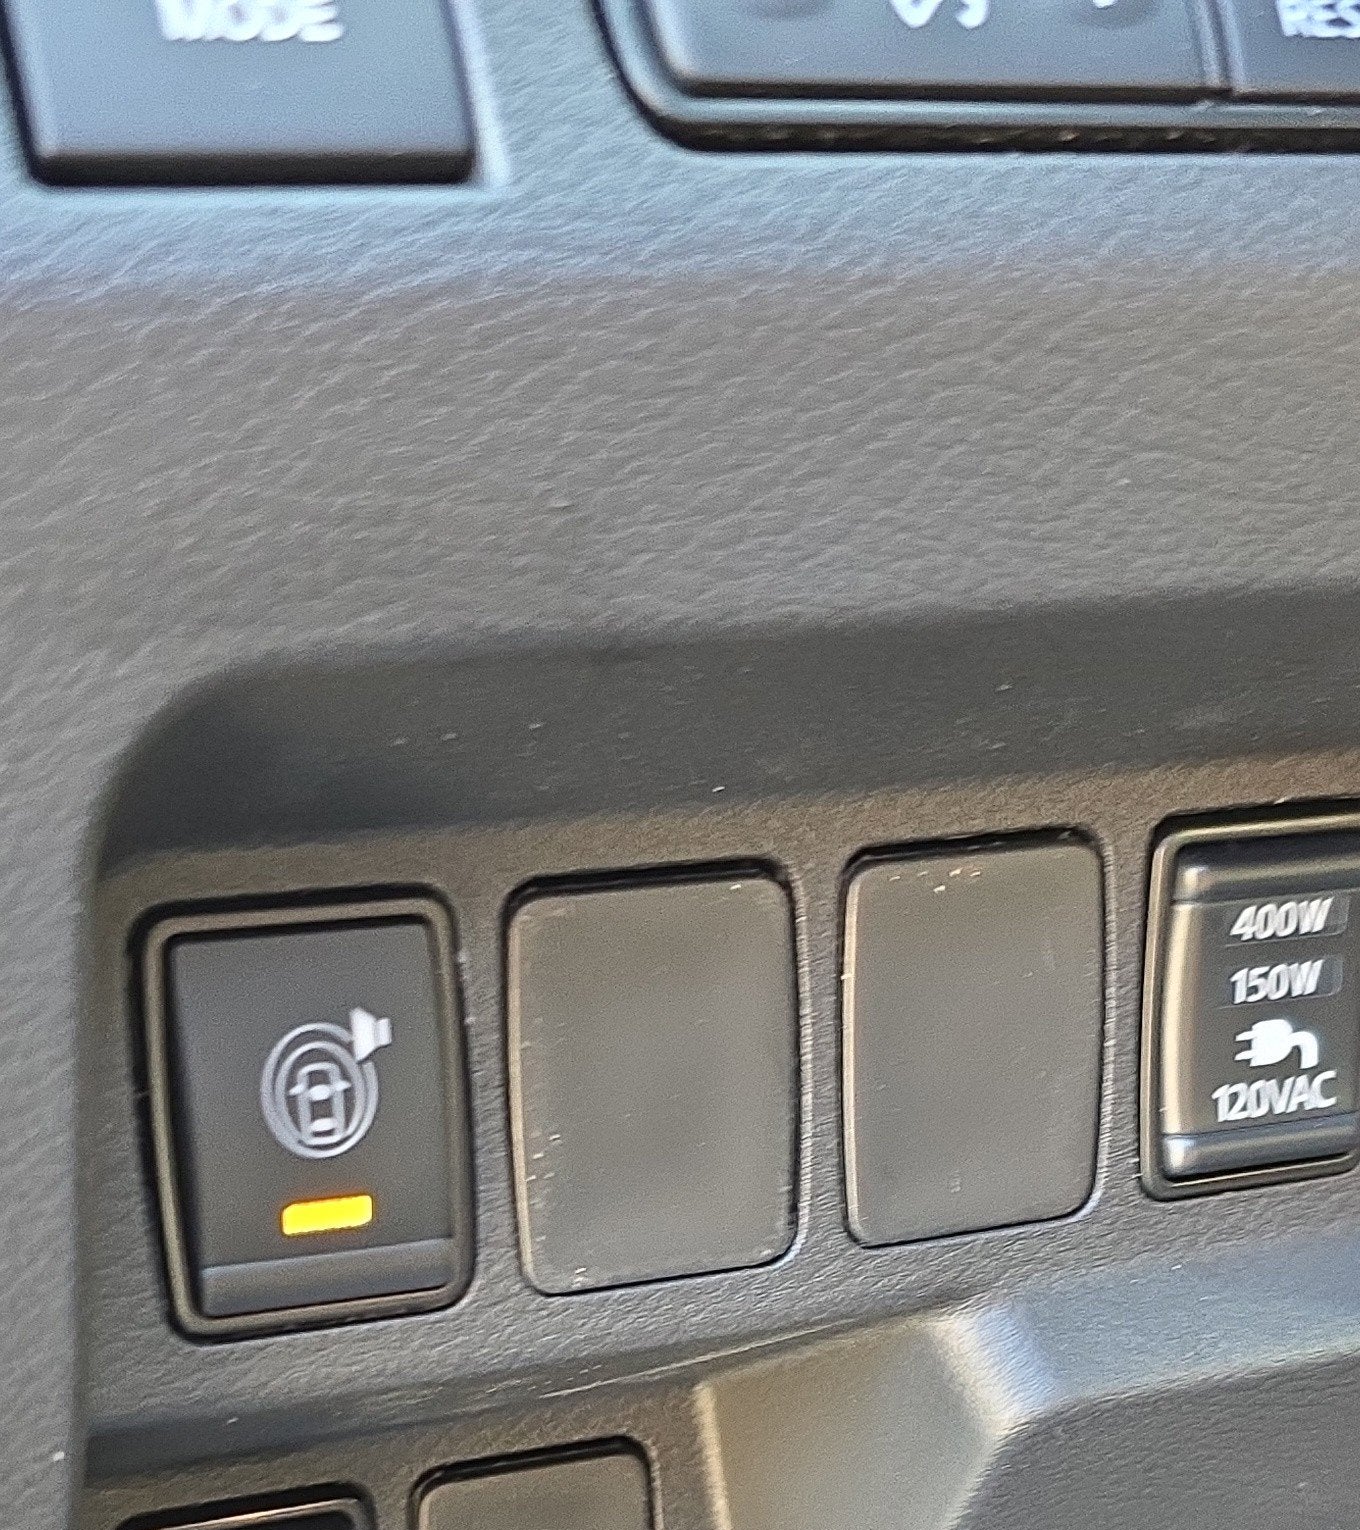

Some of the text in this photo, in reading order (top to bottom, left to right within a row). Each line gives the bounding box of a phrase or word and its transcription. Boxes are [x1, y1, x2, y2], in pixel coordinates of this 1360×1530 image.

[1230, 897, 1334, 940] 400W
[1230, 959, 1324, 1004] 150W
[1211, 1069, 1337, 1122] 120VAC
